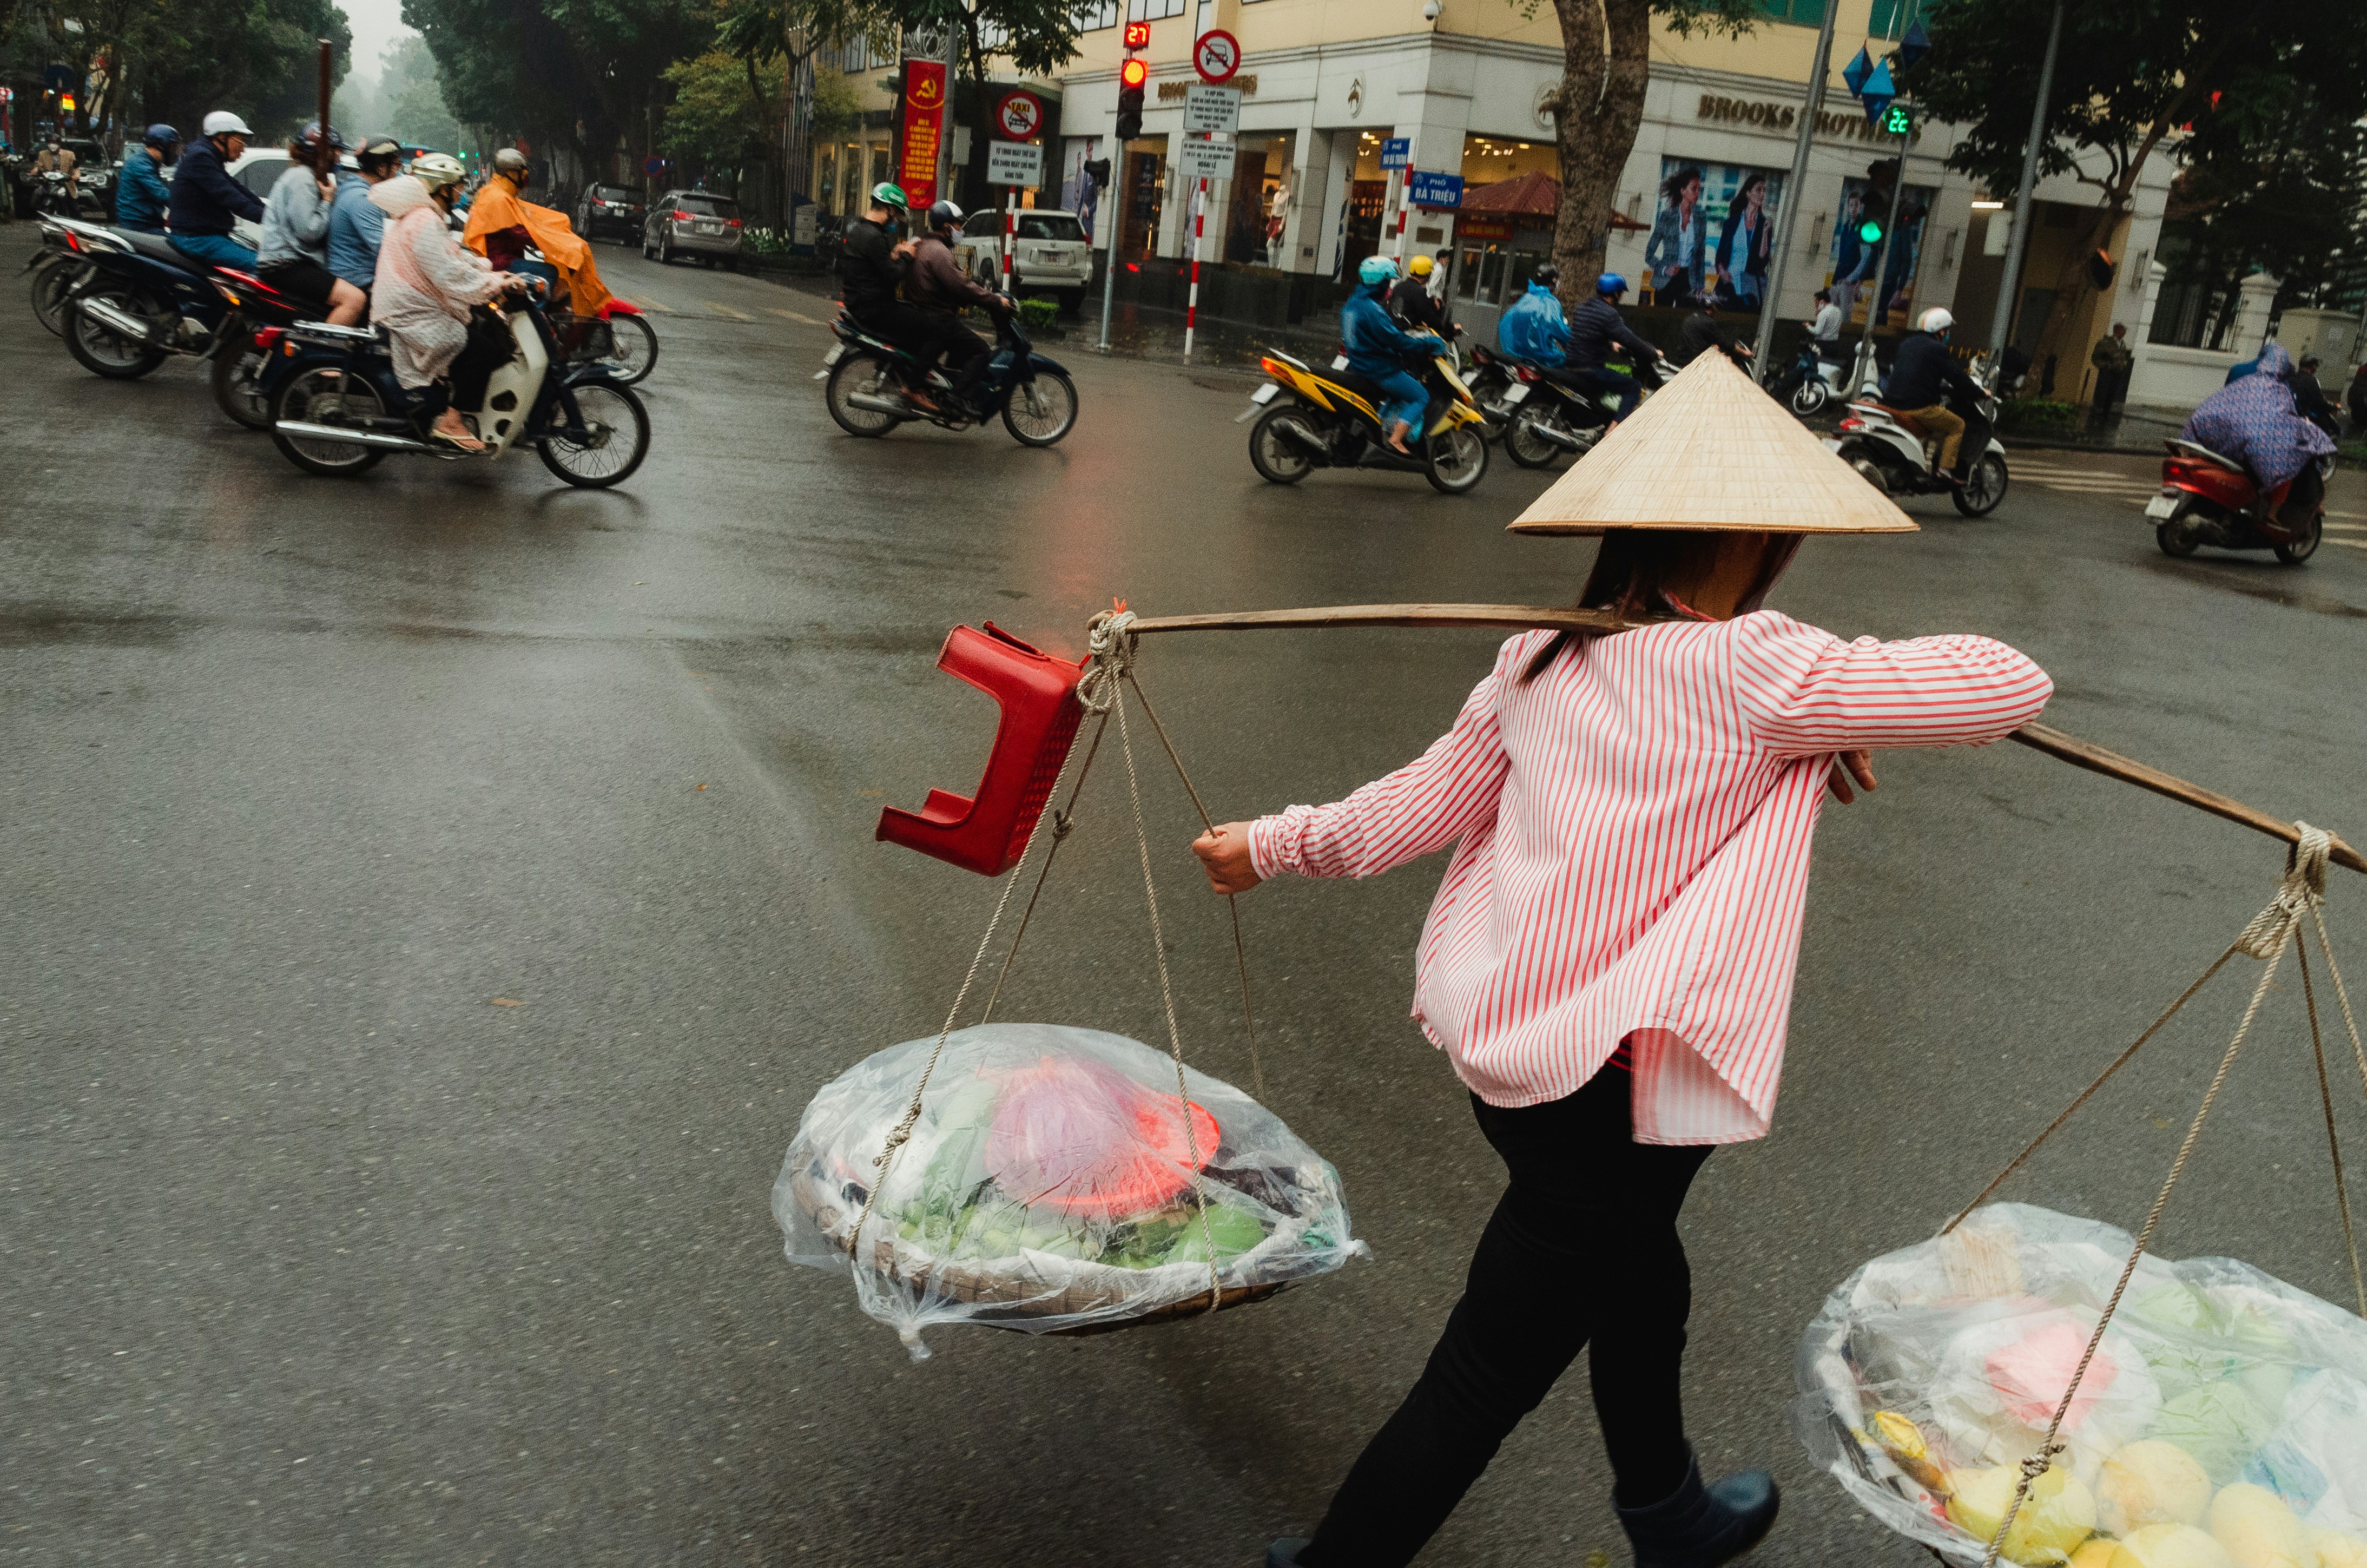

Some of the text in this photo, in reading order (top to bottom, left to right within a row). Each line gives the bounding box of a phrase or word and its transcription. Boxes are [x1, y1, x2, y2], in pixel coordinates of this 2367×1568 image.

[1129, 27, 1146, 42] 27
[1010, 102, 1030, 113] TAXI
[1698, 94, 1794, 129] BROOKS
[1430, 177, 1446, 187] PHỐ
[1415, 185, 1456, 205] BÀ TRIỆU
